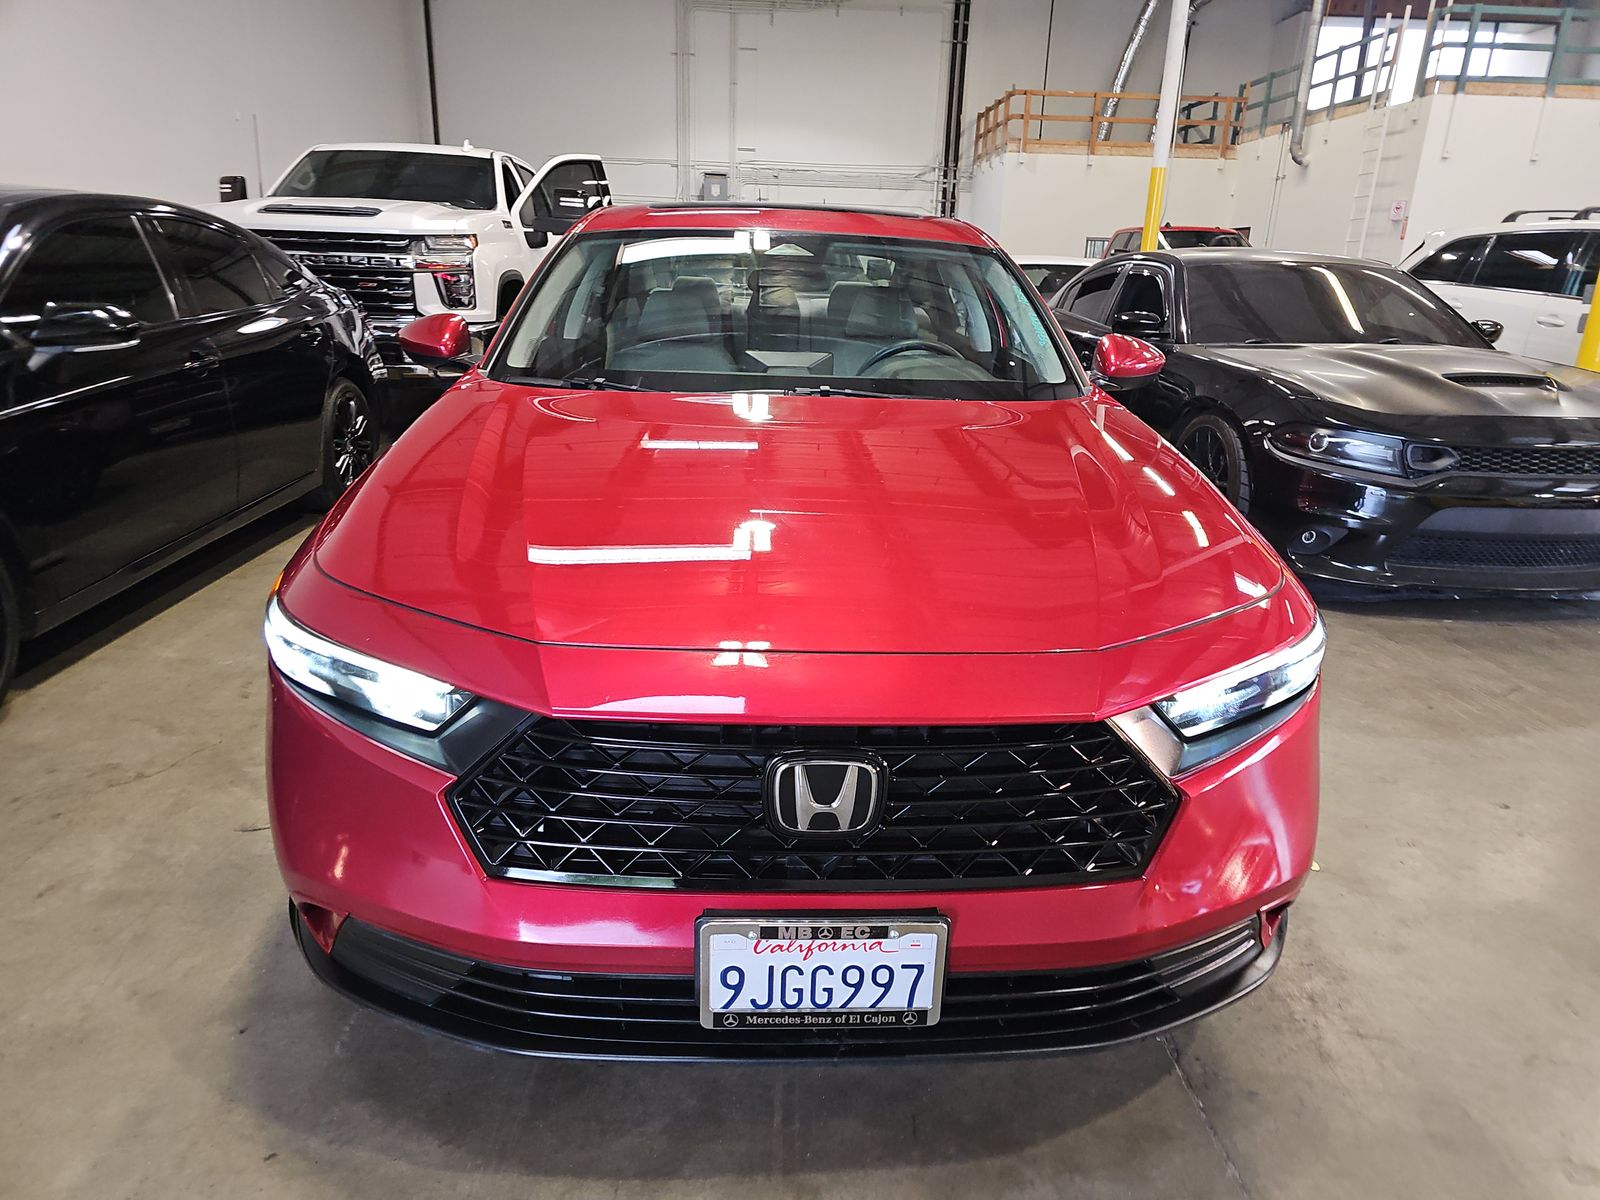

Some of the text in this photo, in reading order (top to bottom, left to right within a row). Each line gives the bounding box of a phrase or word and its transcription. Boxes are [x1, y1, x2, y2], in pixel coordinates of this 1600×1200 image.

[778, 926, 871, 940] MB EC
[753, 938, 899, 961] California
[719, 964, 925, 1010] 9JGG997
[745, 1014, 896, 1025] Mercedes-Benz of El Cajon
